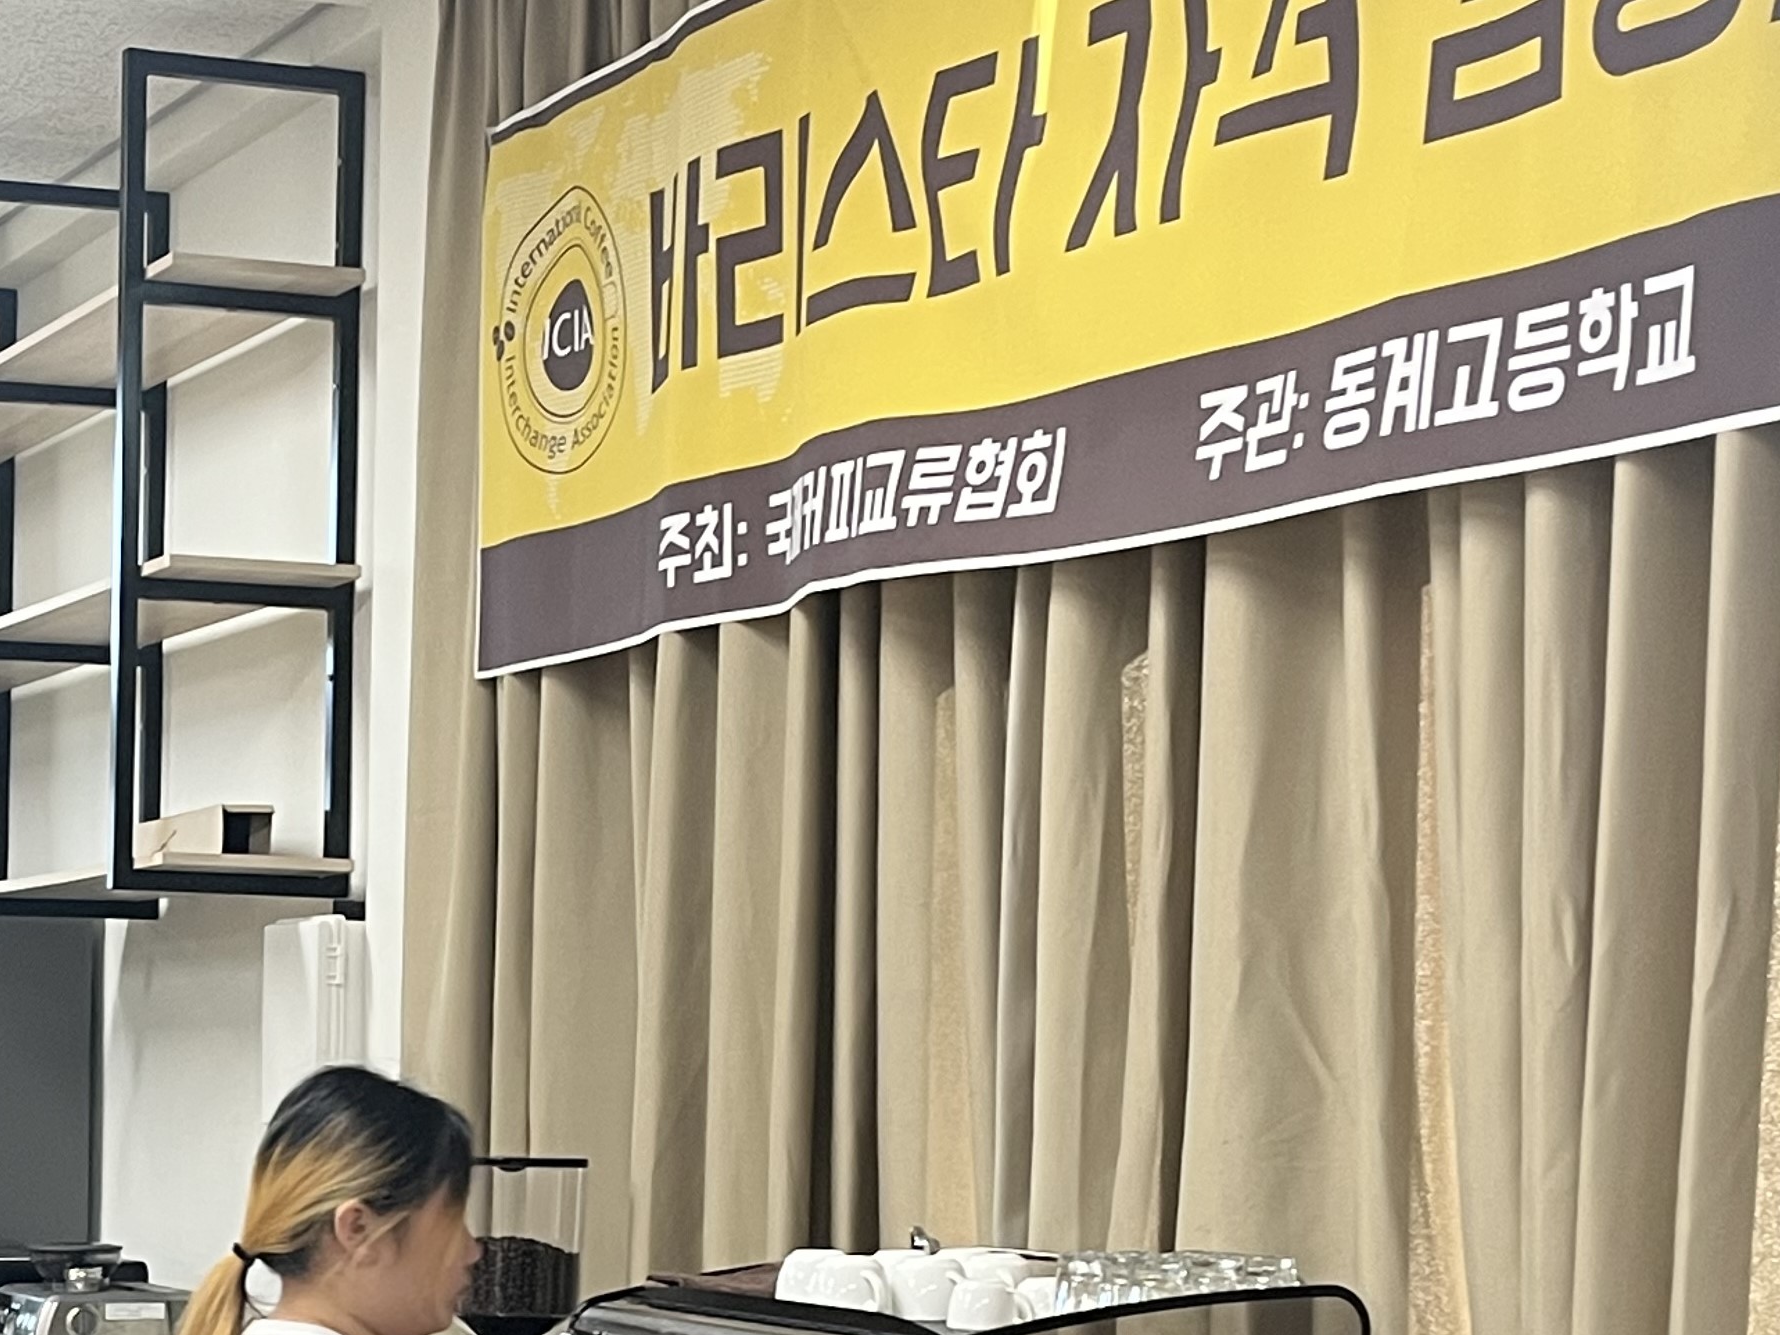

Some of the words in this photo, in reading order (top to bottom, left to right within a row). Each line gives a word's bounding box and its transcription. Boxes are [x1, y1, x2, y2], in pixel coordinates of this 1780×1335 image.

[650, 35, 1047, 394] 바리스타
[505, 354, 567, 460] Interchange
[570, 326, 620, 450] Association
[541, 304, 595, 360] ICIA
[1323, 264, 1697, 451] 동계고등학교
[657, 501, 748, 588] 주최:
